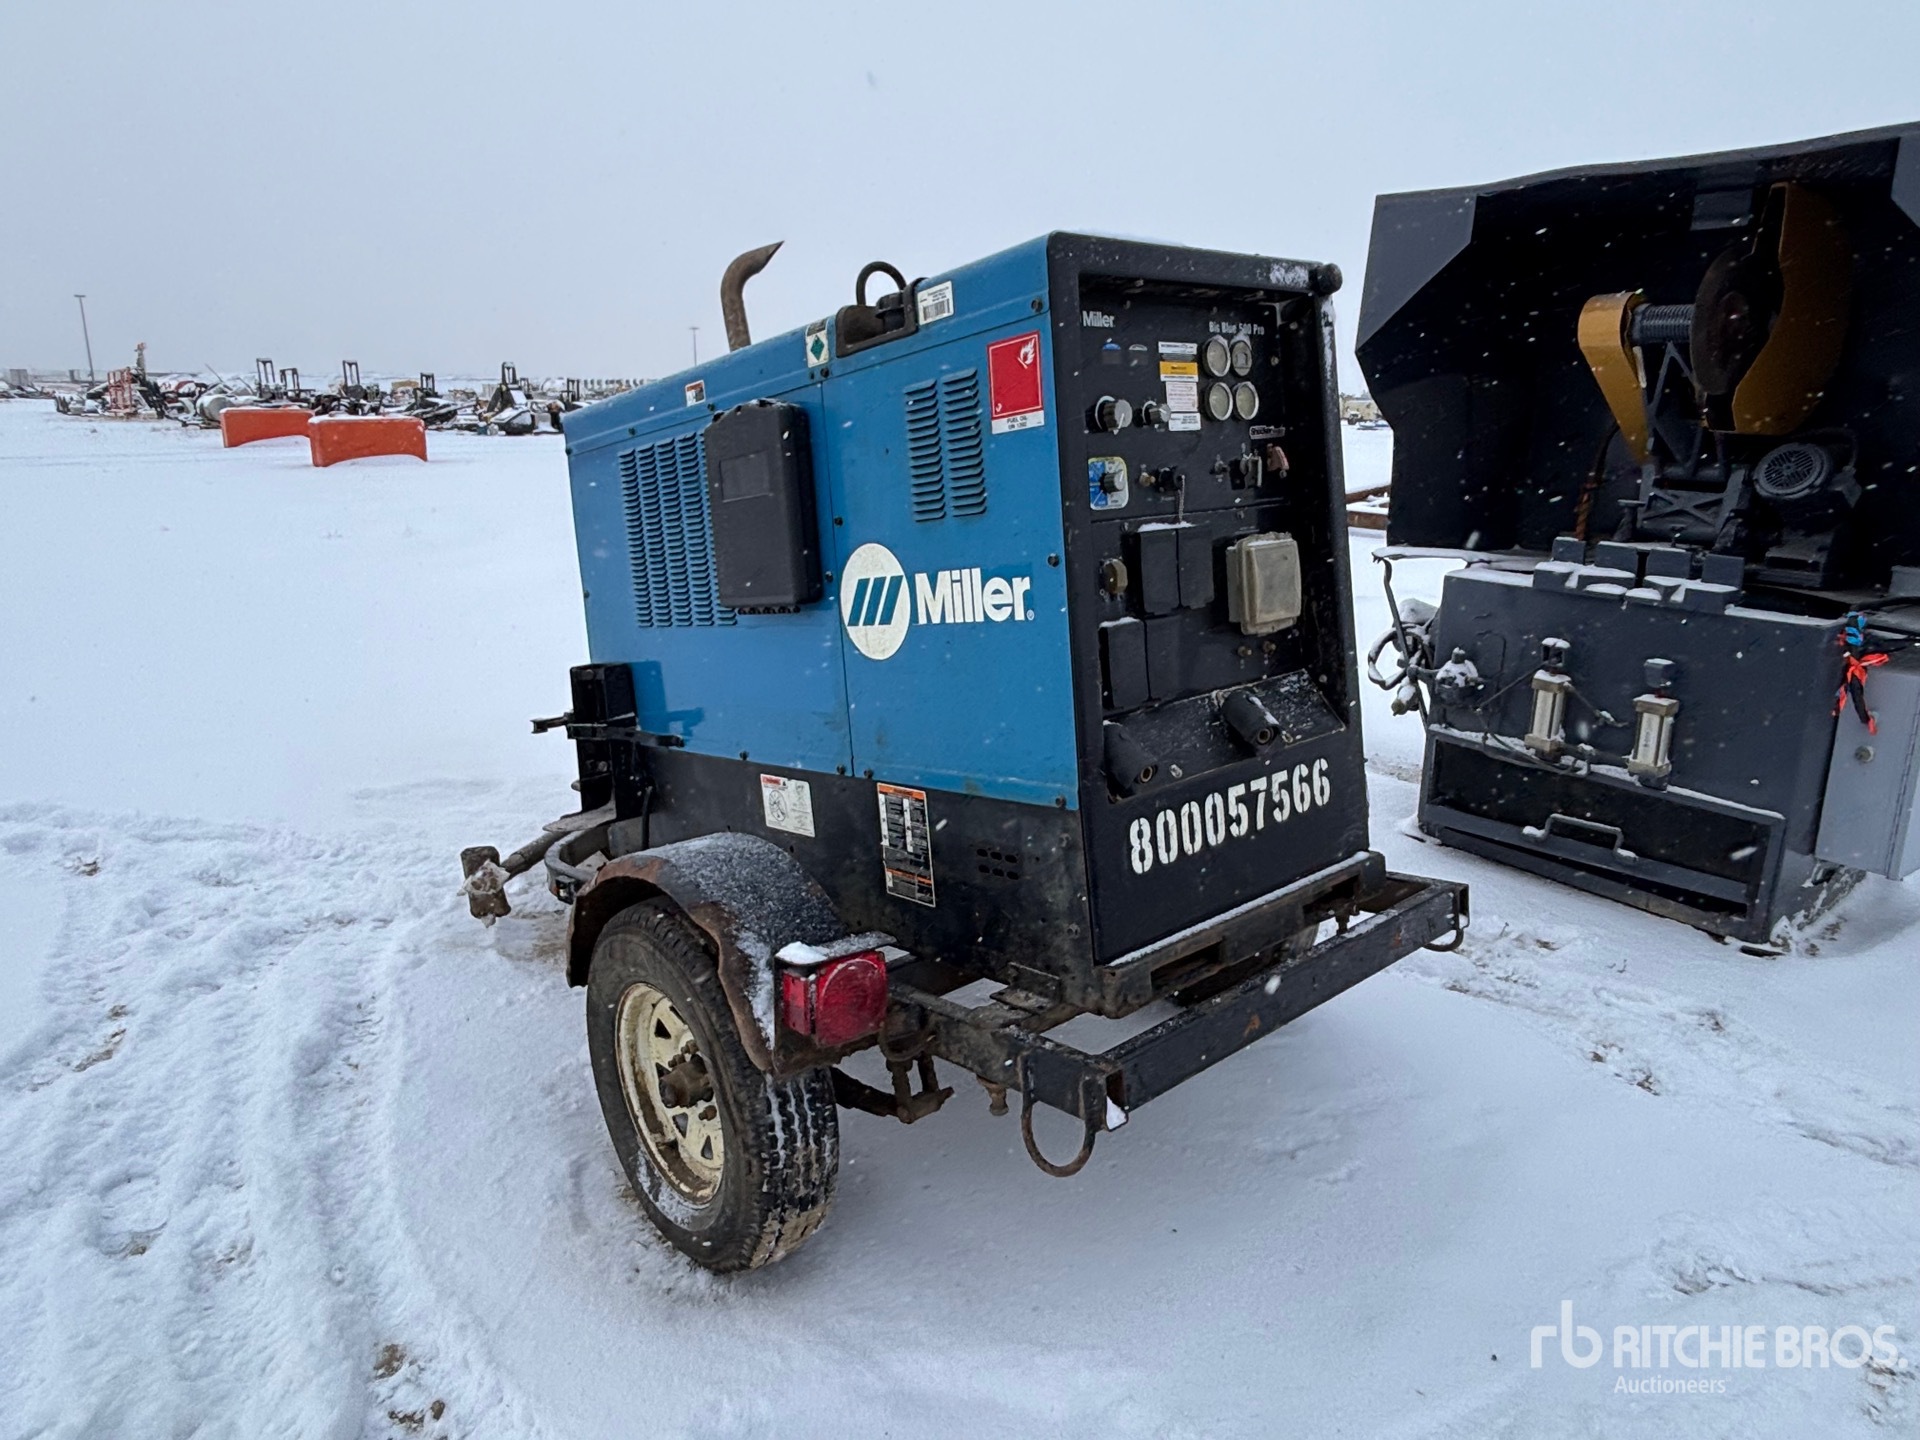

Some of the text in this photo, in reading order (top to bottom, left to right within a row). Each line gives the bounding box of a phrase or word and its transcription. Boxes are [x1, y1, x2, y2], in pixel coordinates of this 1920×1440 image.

[1082, 311, 1115, 328] Miller
[1221, 322, 1237, 334] Blue
[1253, 323, 1265, 336] Pro
[914, 567, 1031, 625] Miller
[1129, 757, 1331, 875] 800057566
